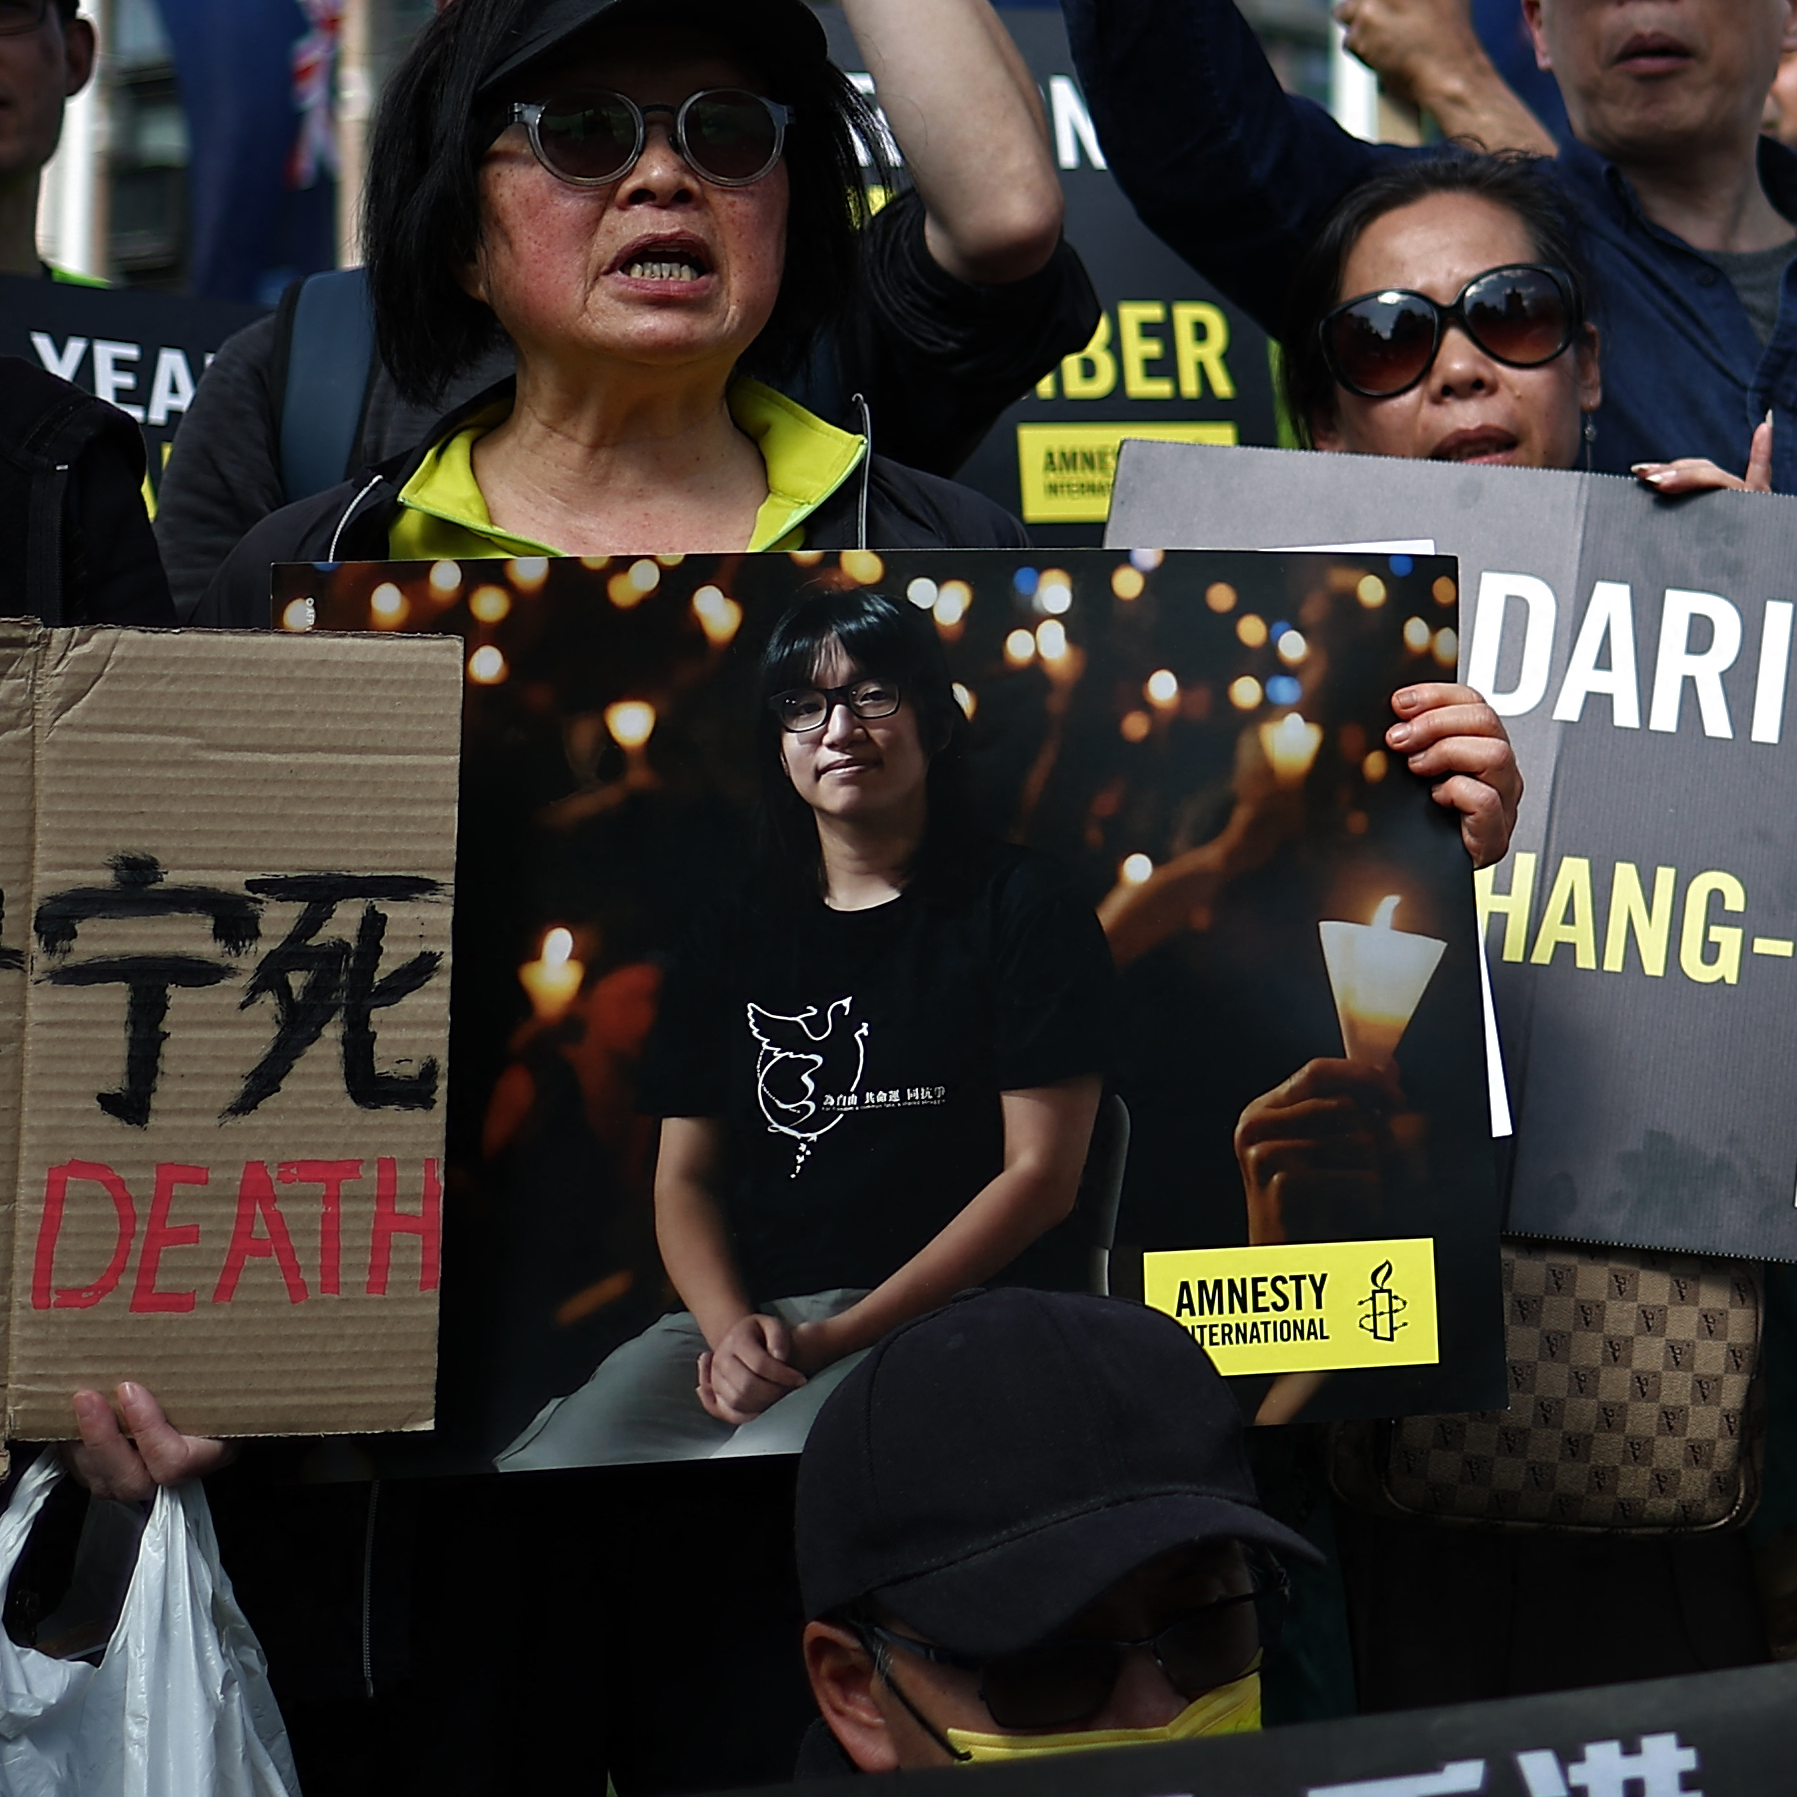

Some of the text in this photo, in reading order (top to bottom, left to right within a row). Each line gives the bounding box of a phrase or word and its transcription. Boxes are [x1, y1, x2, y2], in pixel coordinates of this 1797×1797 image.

[29, 330, 216, 427] YEA
[32, 1157, 442, 1313] DEATH
[1175, 1273, 1328, 1317] AMNESTY
